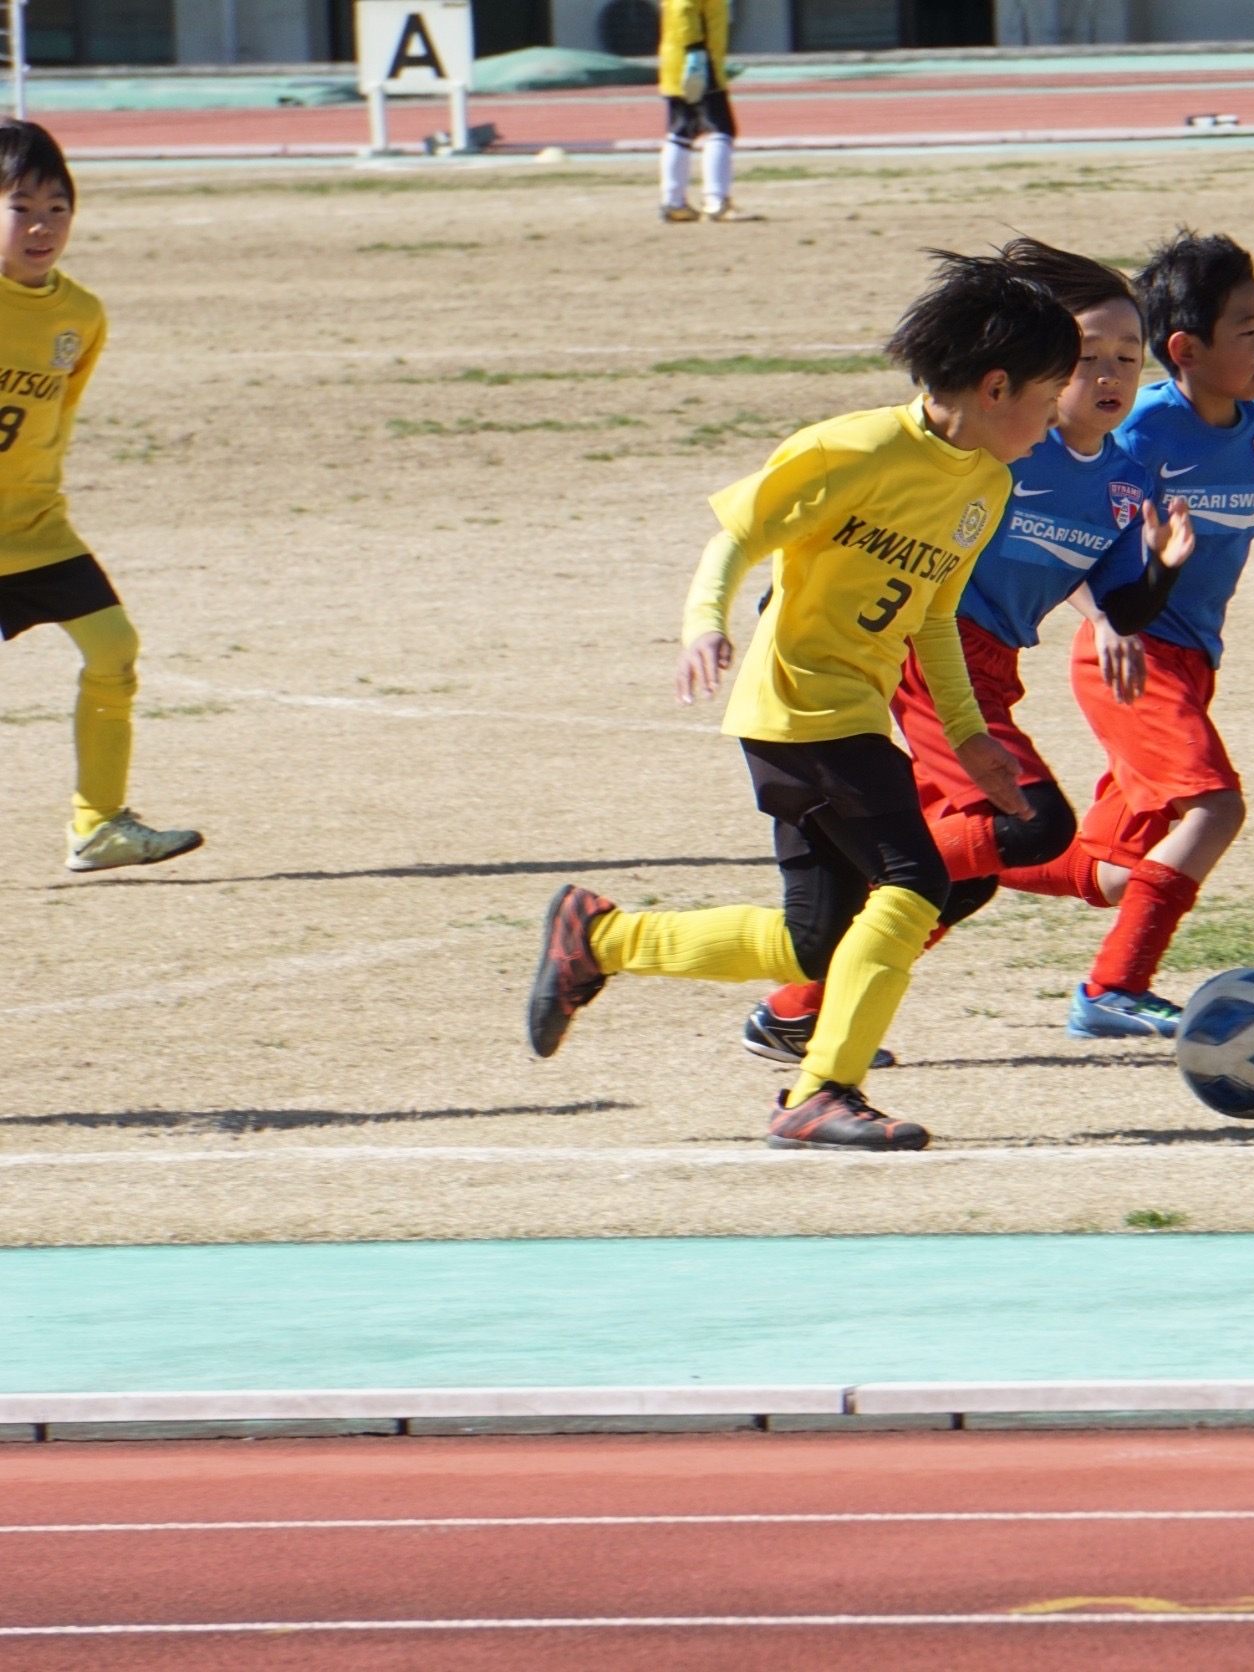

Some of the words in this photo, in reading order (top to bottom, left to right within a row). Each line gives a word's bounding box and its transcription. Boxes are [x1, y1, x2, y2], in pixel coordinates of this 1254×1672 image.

[386, 12, 449, 79] A
[1009, 516, 1070, 542] POCARI
[857, 577, 912, 633] 3
